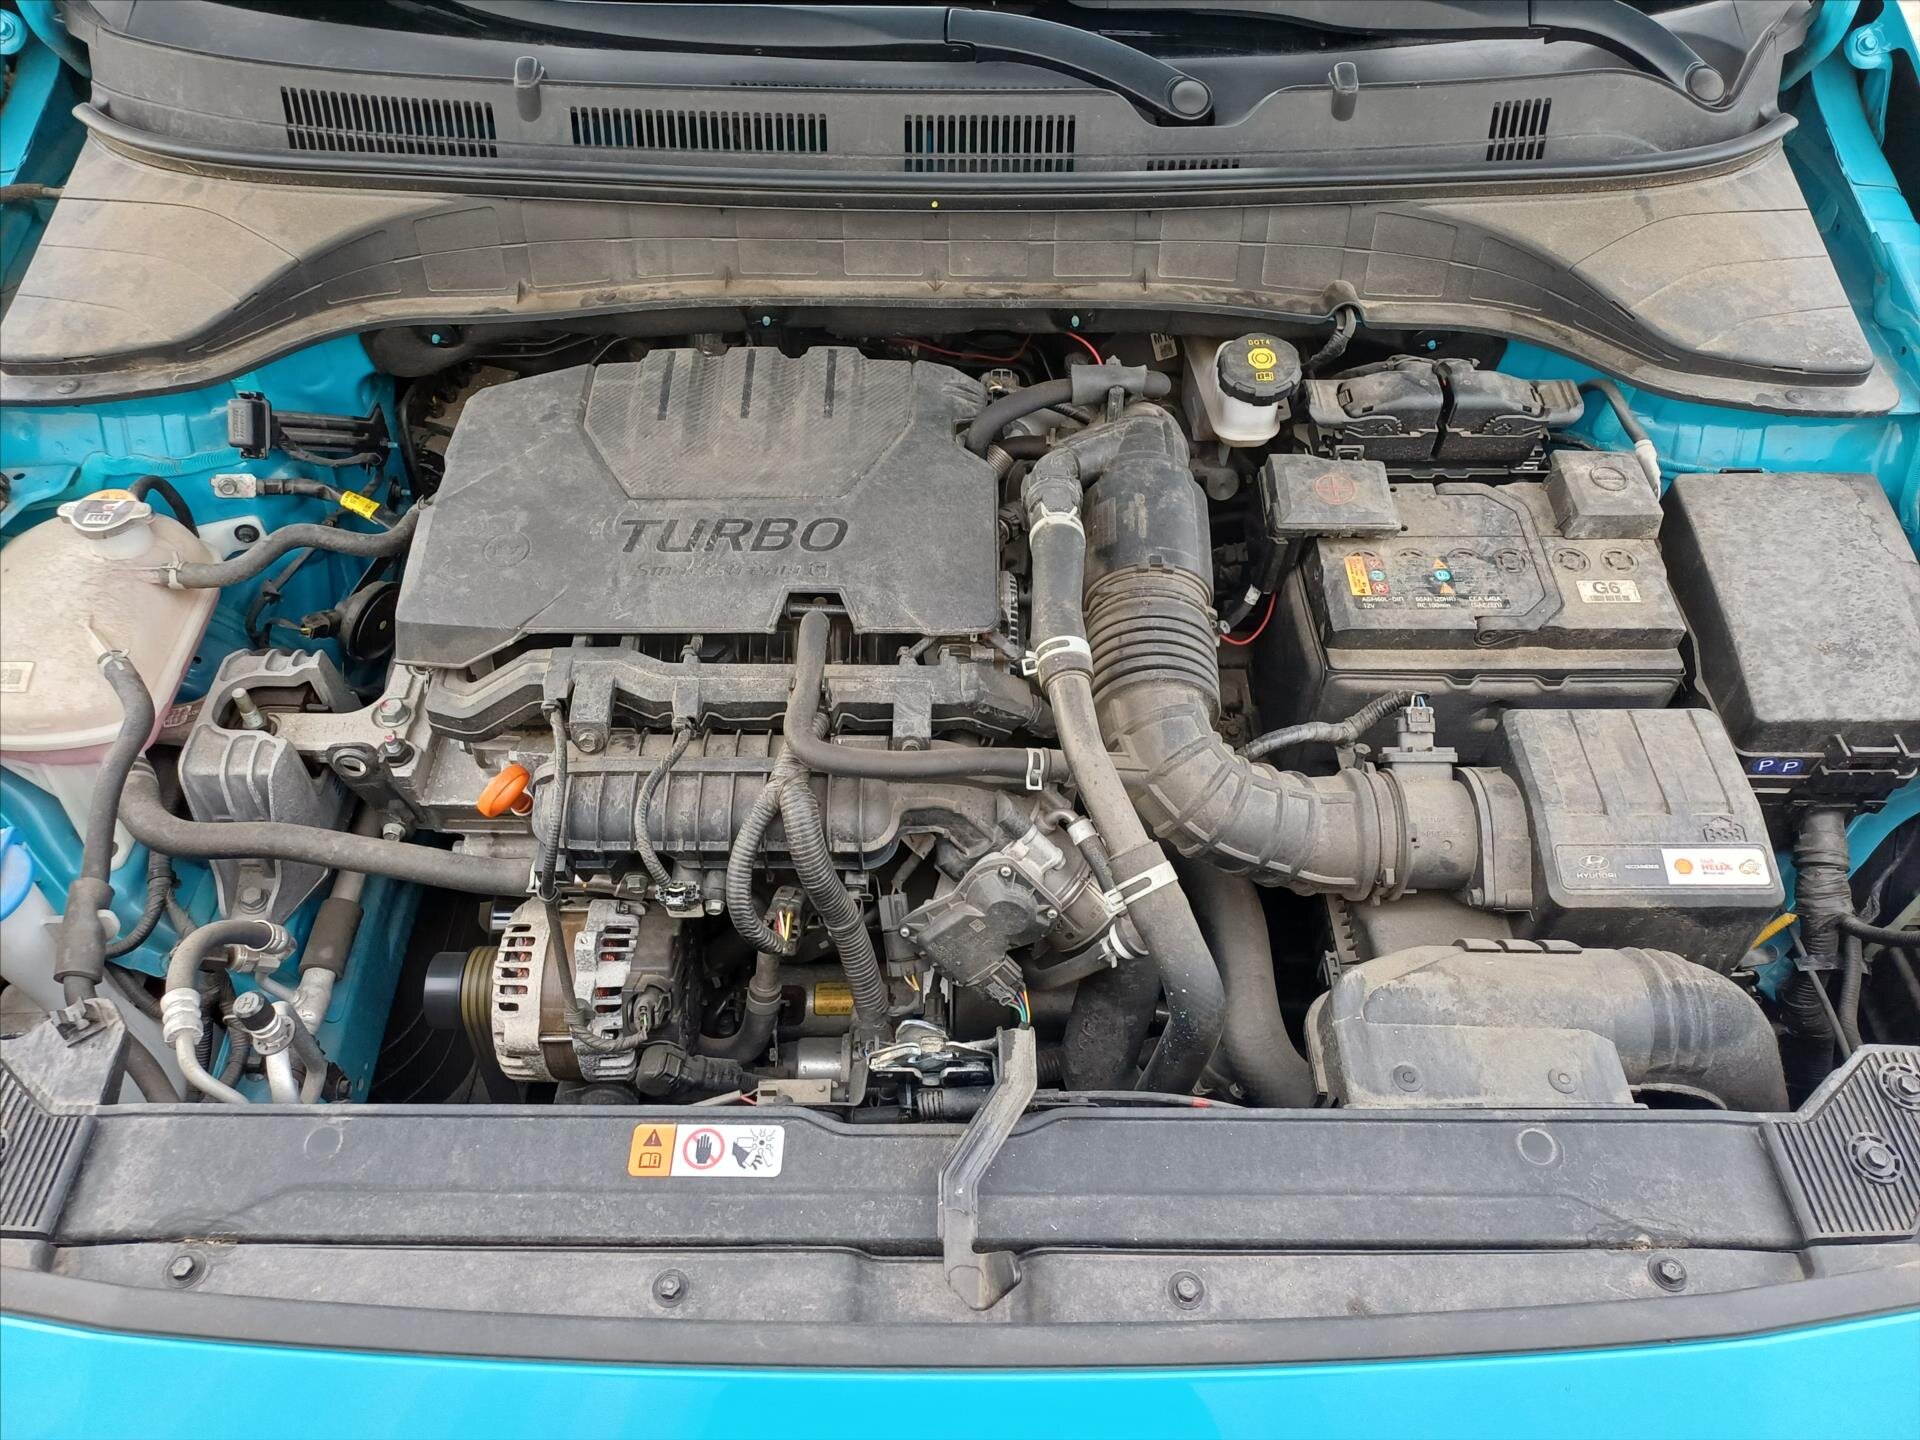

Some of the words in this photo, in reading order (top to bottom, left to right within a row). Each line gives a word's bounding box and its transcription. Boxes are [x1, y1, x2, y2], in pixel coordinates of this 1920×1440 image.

[621, 517, 849, 552] TURBO
[1592, 581, 1621, 594] G6
[1758, 760, 1774, 772] P
[1782, 761, 1798, 773] P
